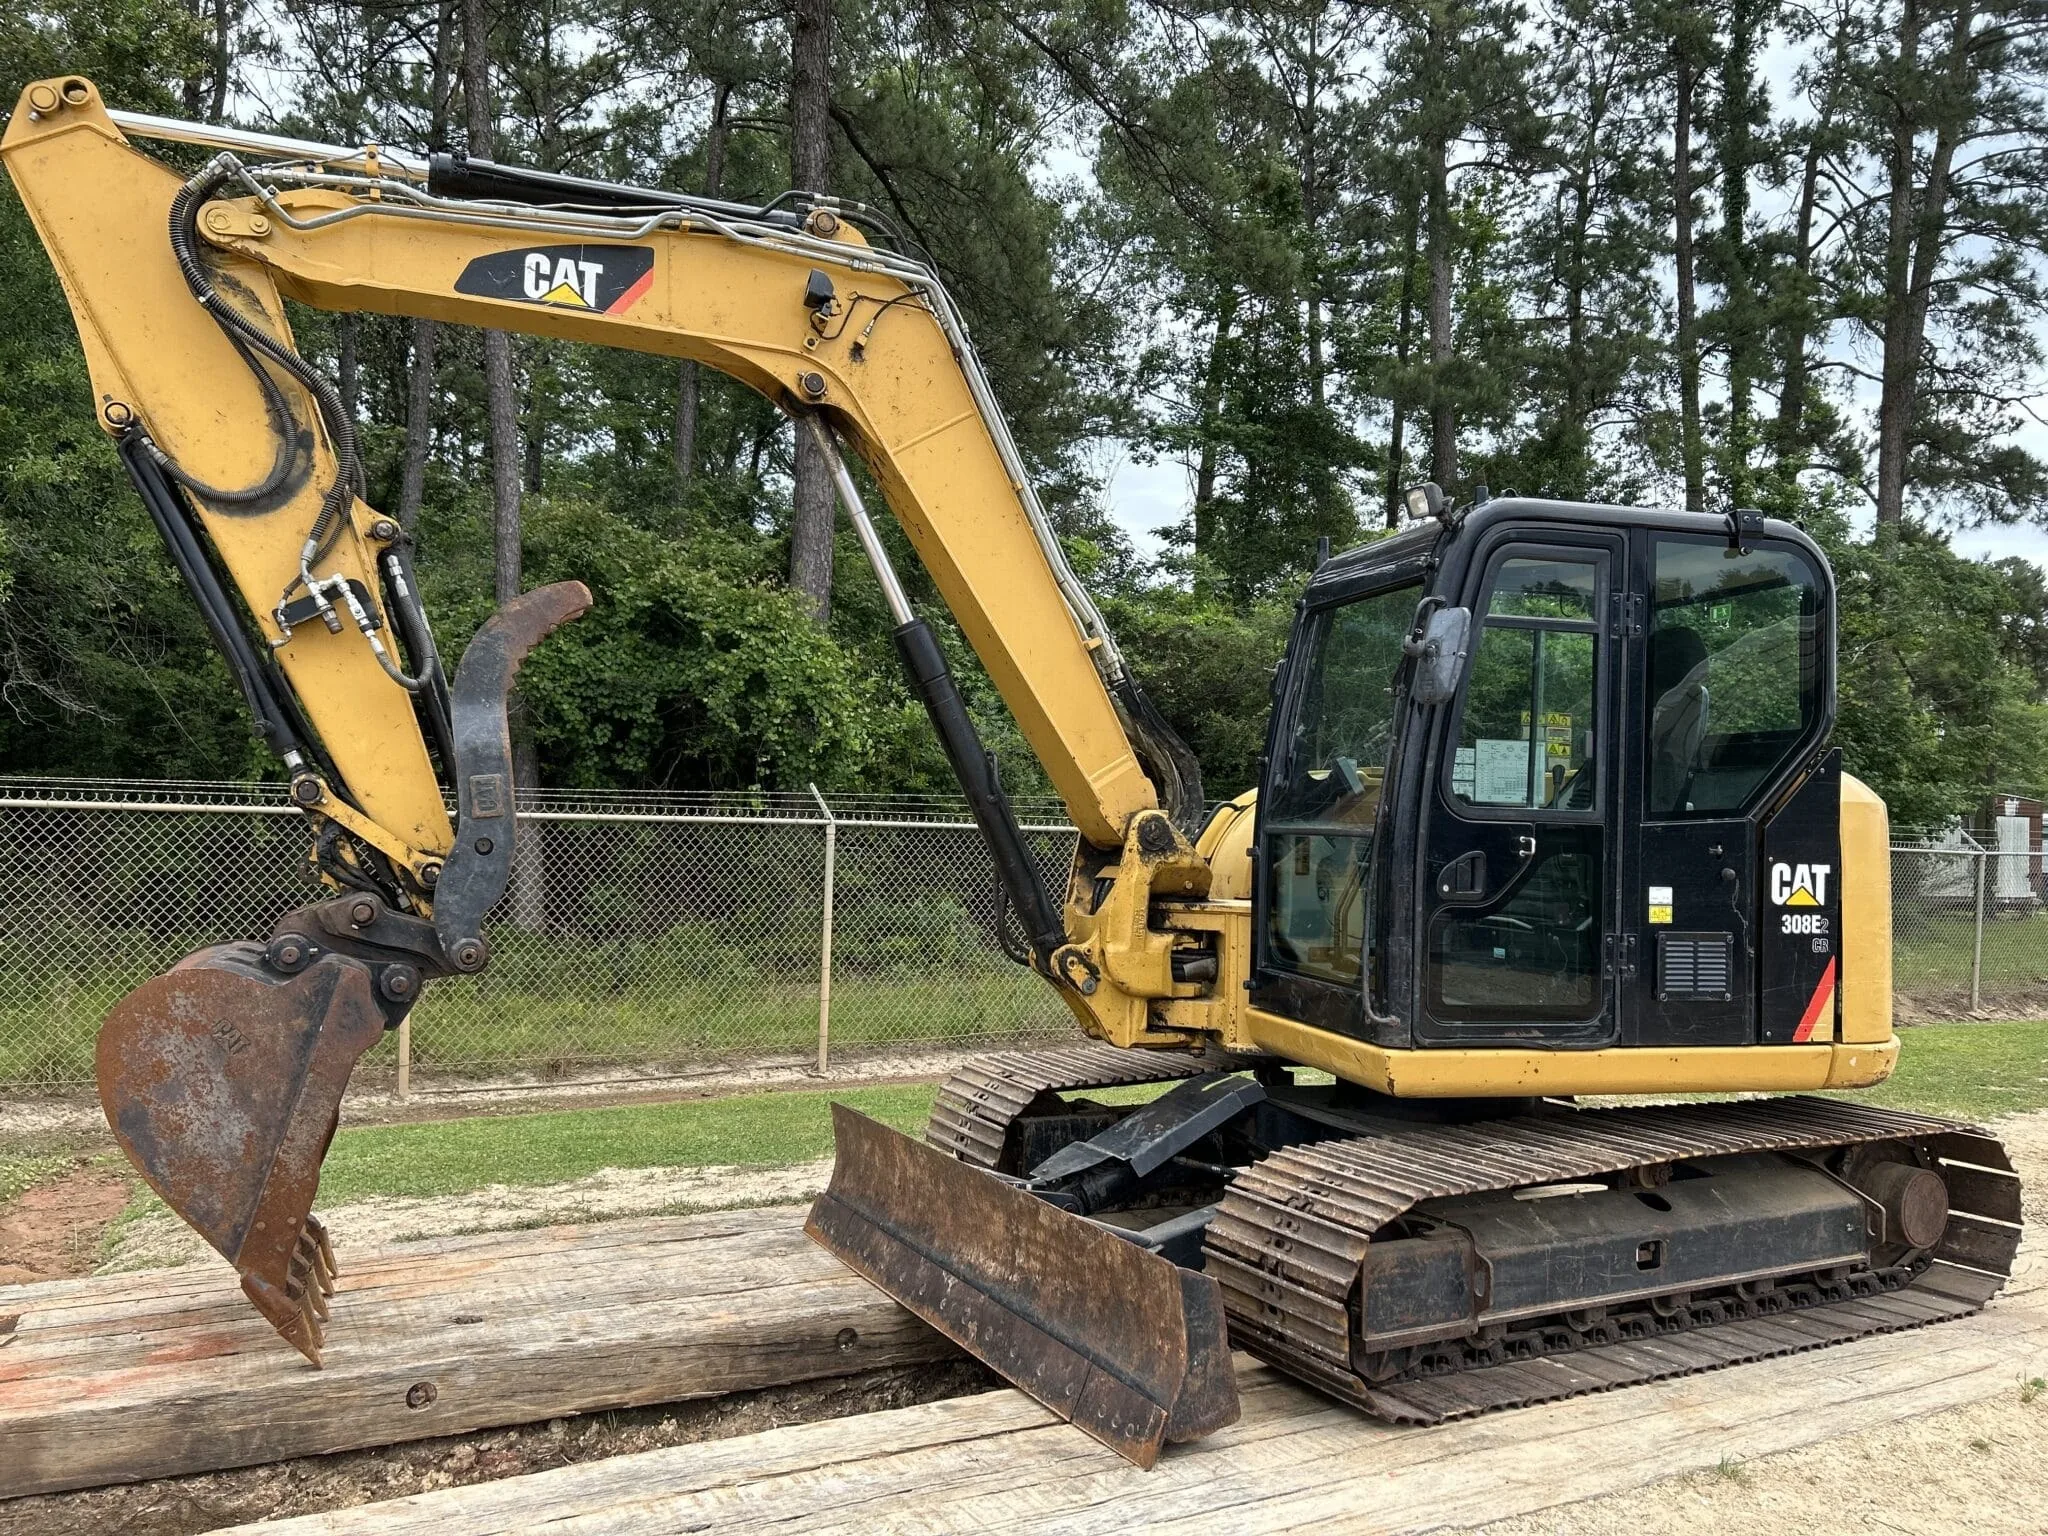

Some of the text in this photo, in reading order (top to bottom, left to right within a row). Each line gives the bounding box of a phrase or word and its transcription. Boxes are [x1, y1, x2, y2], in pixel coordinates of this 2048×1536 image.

[523, 253, 603, 308] CAT
[1771, 862, 1831, 906] CAT
[1812, 938, 1829, 953] CR
[211, 1018, 252, 1055] CAT
